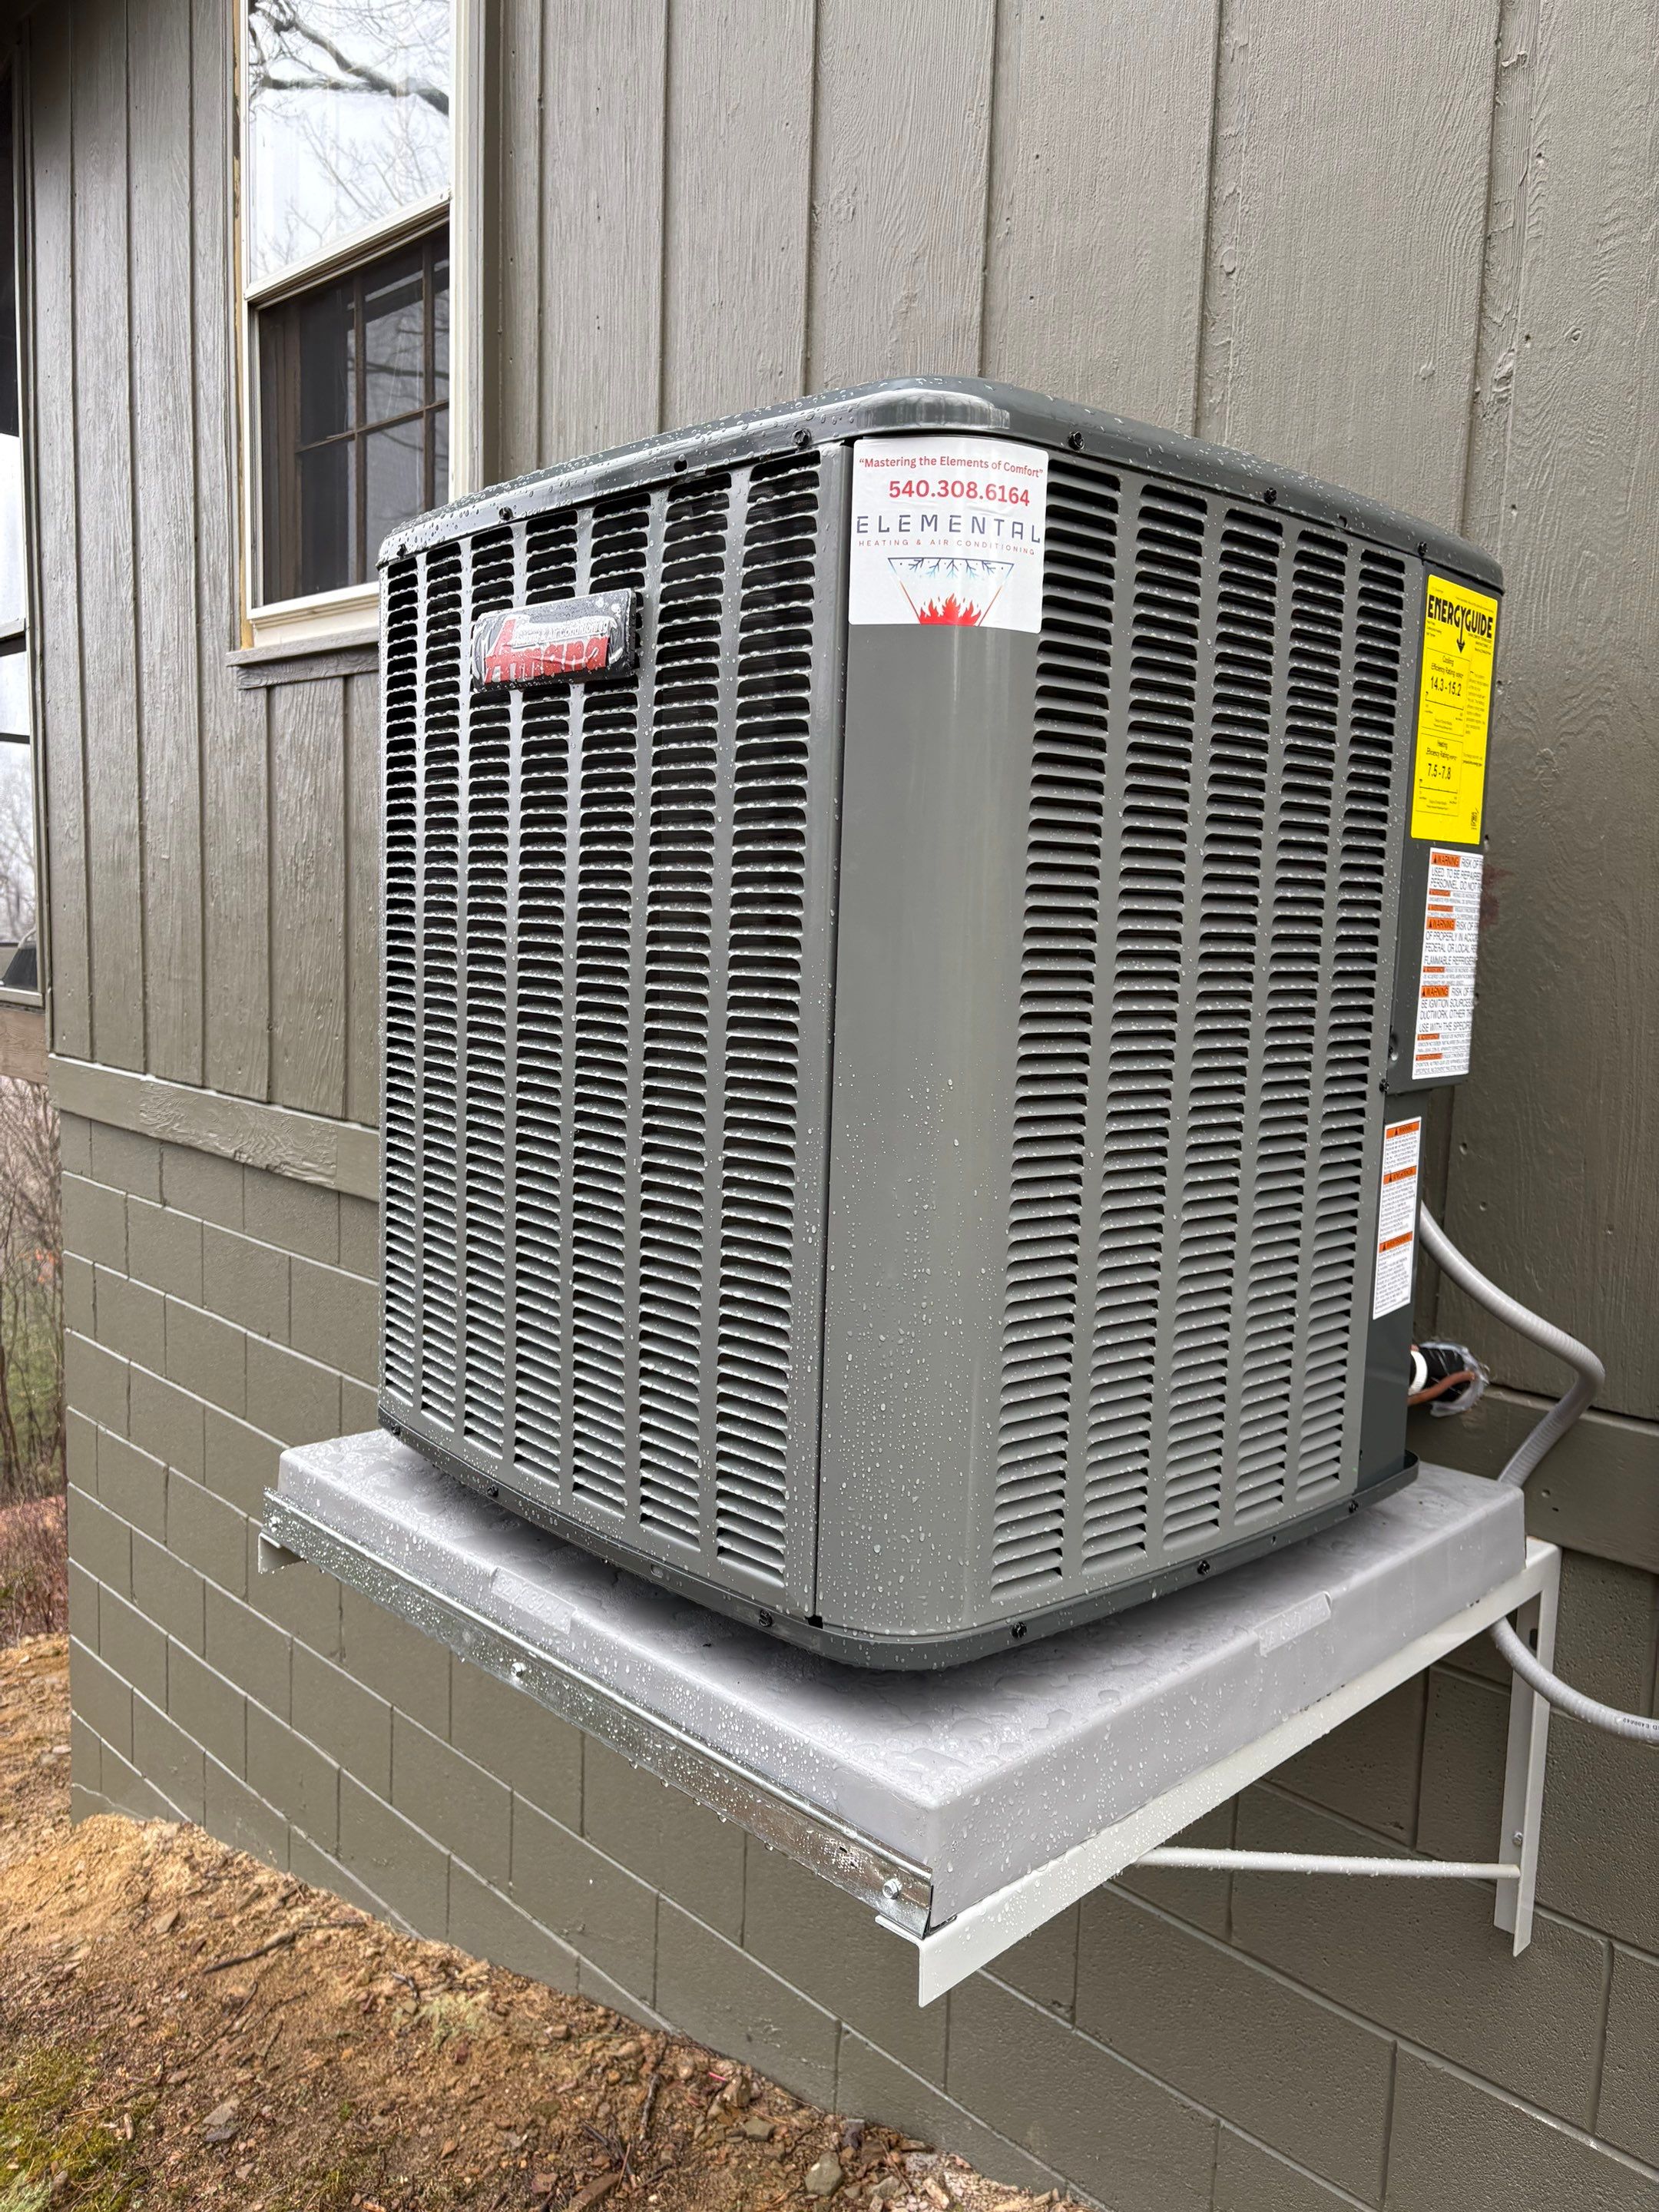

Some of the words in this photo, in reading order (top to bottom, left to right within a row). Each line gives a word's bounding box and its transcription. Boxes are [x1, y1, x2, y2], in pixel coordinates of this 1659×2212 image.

[859, 457, 916, 469] “Mastering
[919, 456, 937, 465] the
[940, 456, 988, 469] Elements
[992, 460, 1002, 470] of
[1004, 462, 1043, 478] Comfort”
[889, 480, 1030, 506] 540.308.6164
[856, 514, 1041, 544] ELEMENTAL
[957, 540, 1035, 555] CONDITIONING
[1428, 594, 1493, 638] ENERGYGUIDE
[560, 621, 608, 637] Conditioning
[484, 619, 610, 684] Amana
[1431, 676, 1444, 691] 14.3
[1449, 680, 1462, 697] 15.2
[1428, 763, 1438, 777] 7.5
[1442, 766, 1451, 780] 7.8
